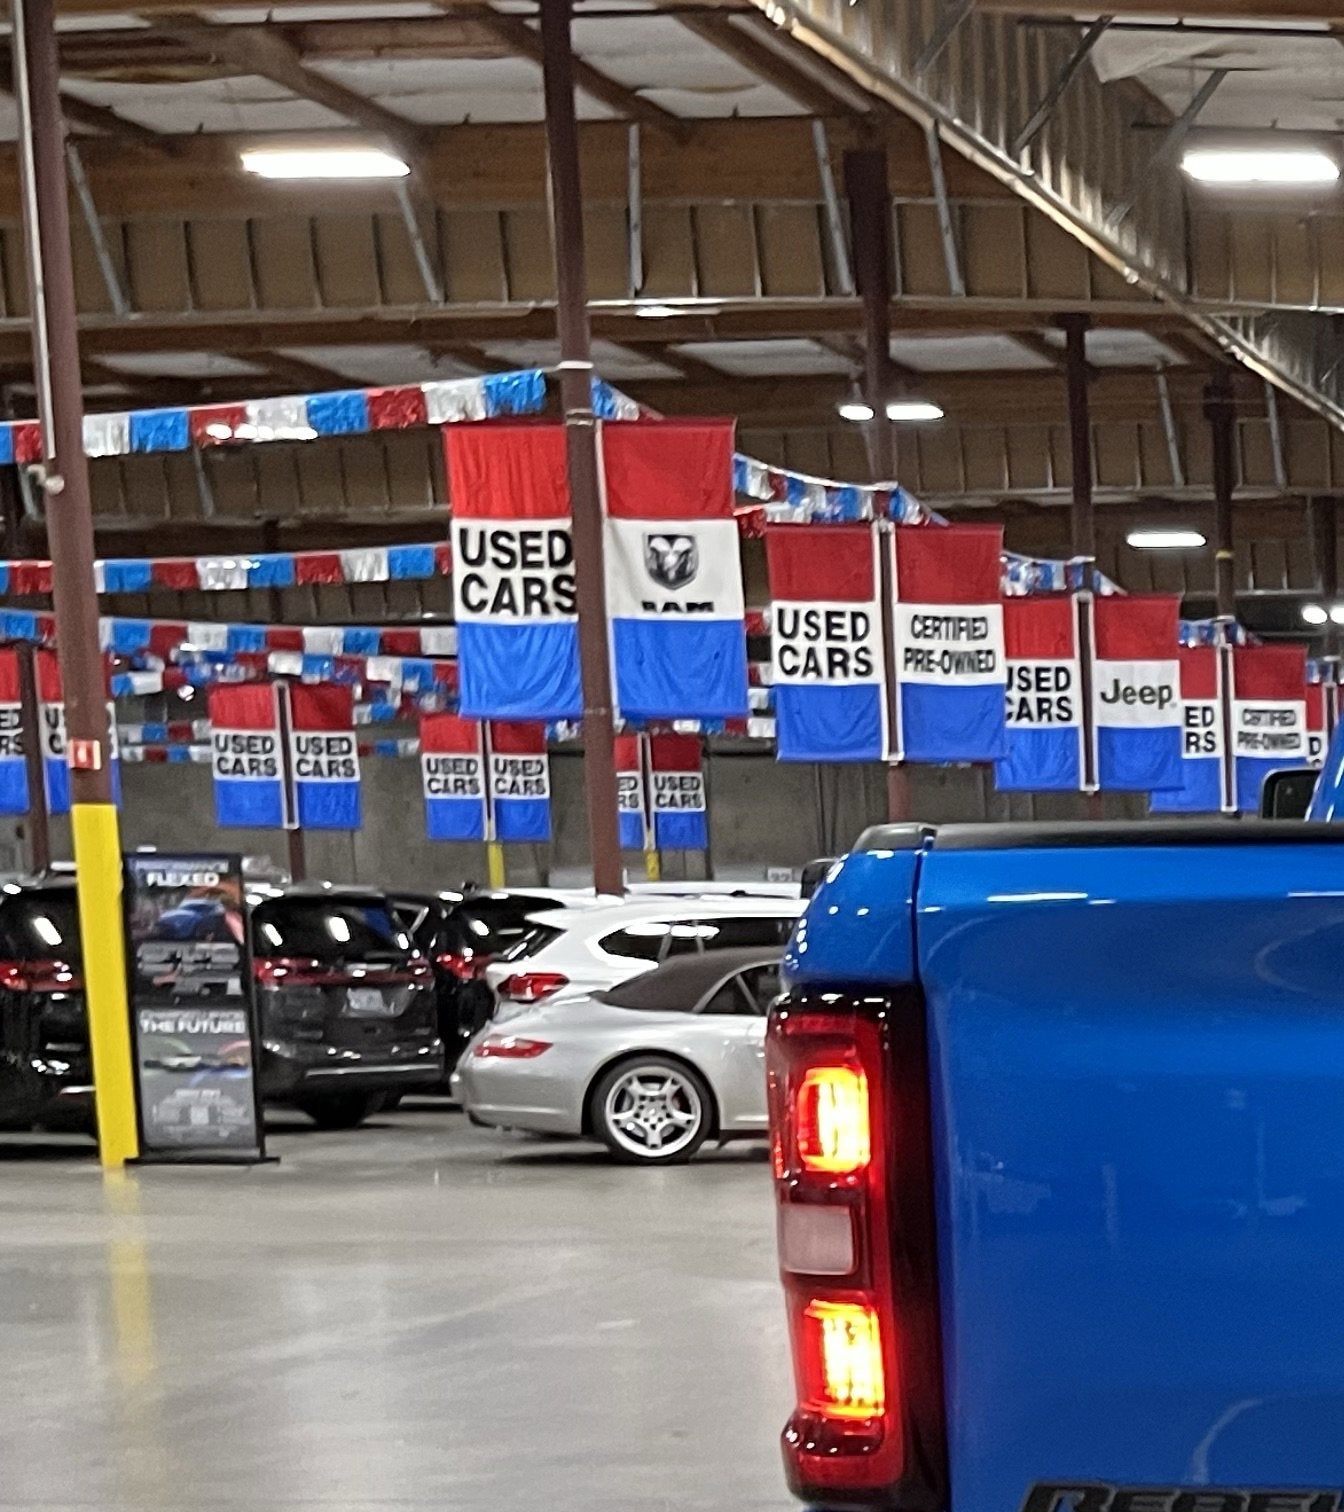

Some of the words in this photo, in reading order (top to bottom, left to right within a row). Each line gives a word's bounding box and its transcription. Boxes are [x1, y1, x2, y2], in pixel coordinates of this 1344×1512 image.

[459, 527, 573, 570] USED
[460, 573, 577, 615] CARS
[777, 608, 870, 642] USED
[911, 614, 988, 641] CERTIFIED
[778, 644, 873, 678] CARS
[903, 647, 996, 675] PRE-OWNED
[1100, 678, 1173, 710] Jeep
[1185, 706, 1215, 727] ED
[215, 734, 275, 754] USED
[296, 736, 352, 756] USED
[1185, 731, 1217, 753] RS
[217, 757, 277, 776] CARS
[296, 758, 356, 778] CARS
[427, 758, 478, 775] USED
[494, 758, 544, 776] USED
[427, 778, 480, 795] CARS
[494, 777, 546, 795] CARS
[617, 776, 639, 791] ED
[655, 775, 700, 791] USED
[618, 793, 640, 808] RS
[655, 793, 702, 808] CARS
